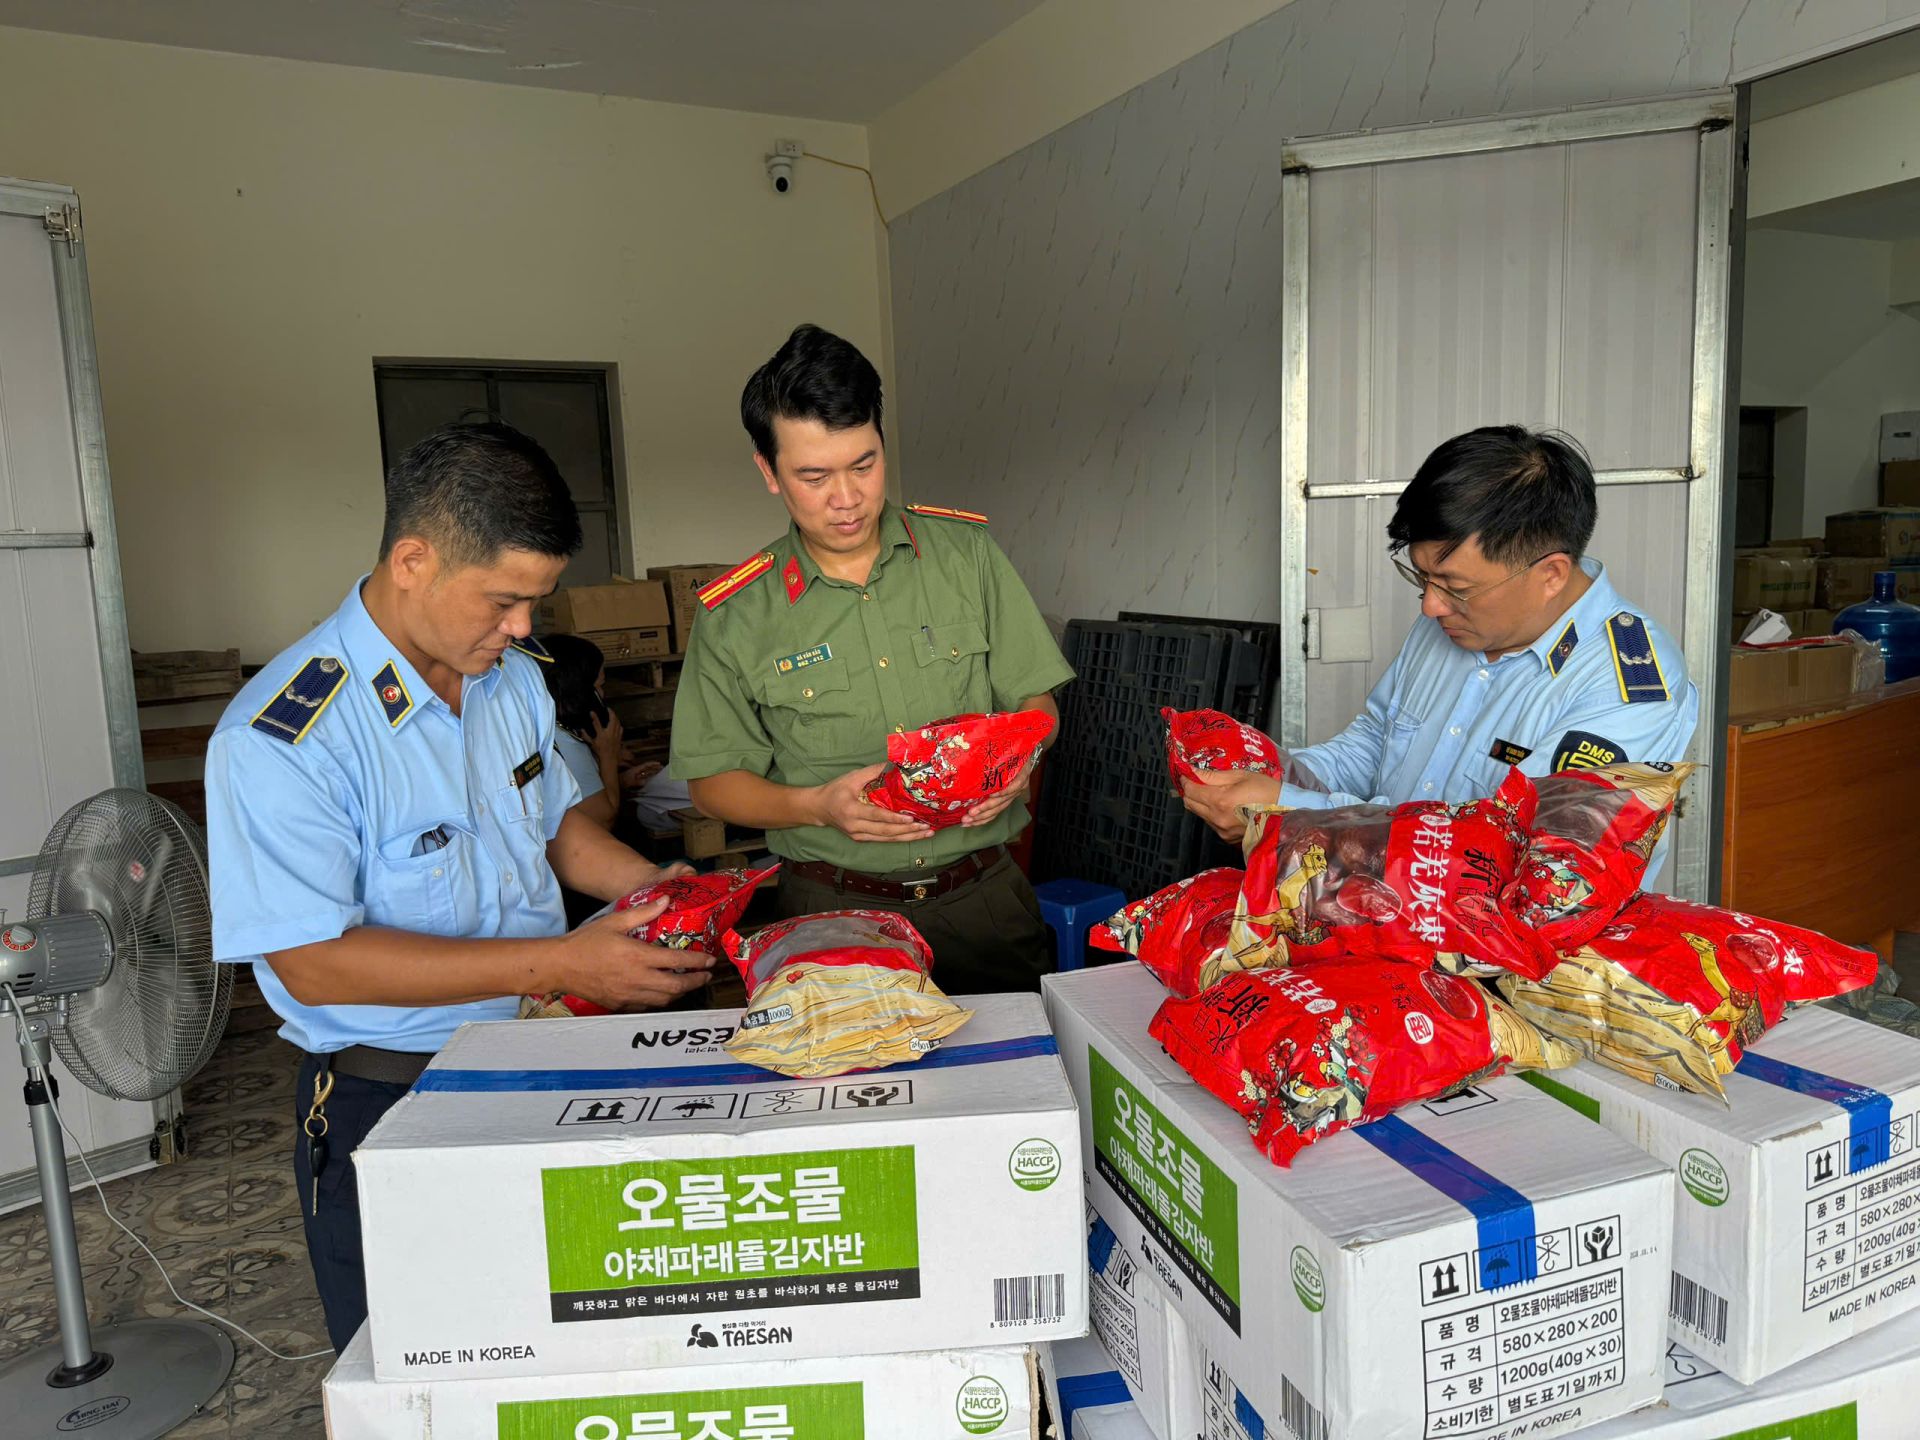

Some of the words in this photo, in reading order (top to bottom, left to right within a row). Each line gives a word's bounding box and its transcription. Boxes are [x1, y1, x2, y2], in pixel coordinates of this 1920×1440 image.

[1578, 740, 1615, 764] DMS
[631, 1026, 735, 1049] ESAN
[1017, 1156, 1054, 1167] HACCP
[1114, 1087, 1204, 1219] 오물조물
[1687, 1162, 1722, 1186] HACCP
[617, 1166, 846, 1232] 오물조물
[1109, 1136, 1214, 1271] 야채파래돌김자반
[604, 1232, 866, 1281] 야채파래돌김자반
[1153, 1255, 1183, 1301] TAESAN
[1295, 1260, 1321, 1289] HACCP
[1808, 1271, 1850, 1301] 소비기한
[573, 1299, 620, 1312] 깨끗하고
[625, 1295, 648, 1307] 맑은
[654, 1291, 700, 1305] 바다에서
[706, 1290, 729, 1302] 자란
[734, 1287, 768, 1300] 원초를
[774, 1283, 820, 1298] 바삭하게
[826, 1281, 848, 1294] 볶은
[854, 1278, 900, 1292] 돌김자반
[1500, 1277, 1617, 1323] 오물조물야채파래돌김자반
[1828, 1299, 1861, 1323] MADE
[1865, 1291, 1876, 1307] IN
[1879, 1274, 1916, 1298] KOREA
[722, 1326, 792, 1347] TAESAN
[404, 1350, 452, 1366] MADE
[458, 1349, 474, 1362] IN
[480, 1345, 536, 1361] KOREA
[965, 1397, 1001, 1409] HACCP
[1432, 1404, 1494, 1431] 소비기한
[1508, 1367, 1616, 1414] 별도표기일까지
[1511, 1424, 1527, 1438] IN
[1531, 1407, 1581, 1431] KOREA
